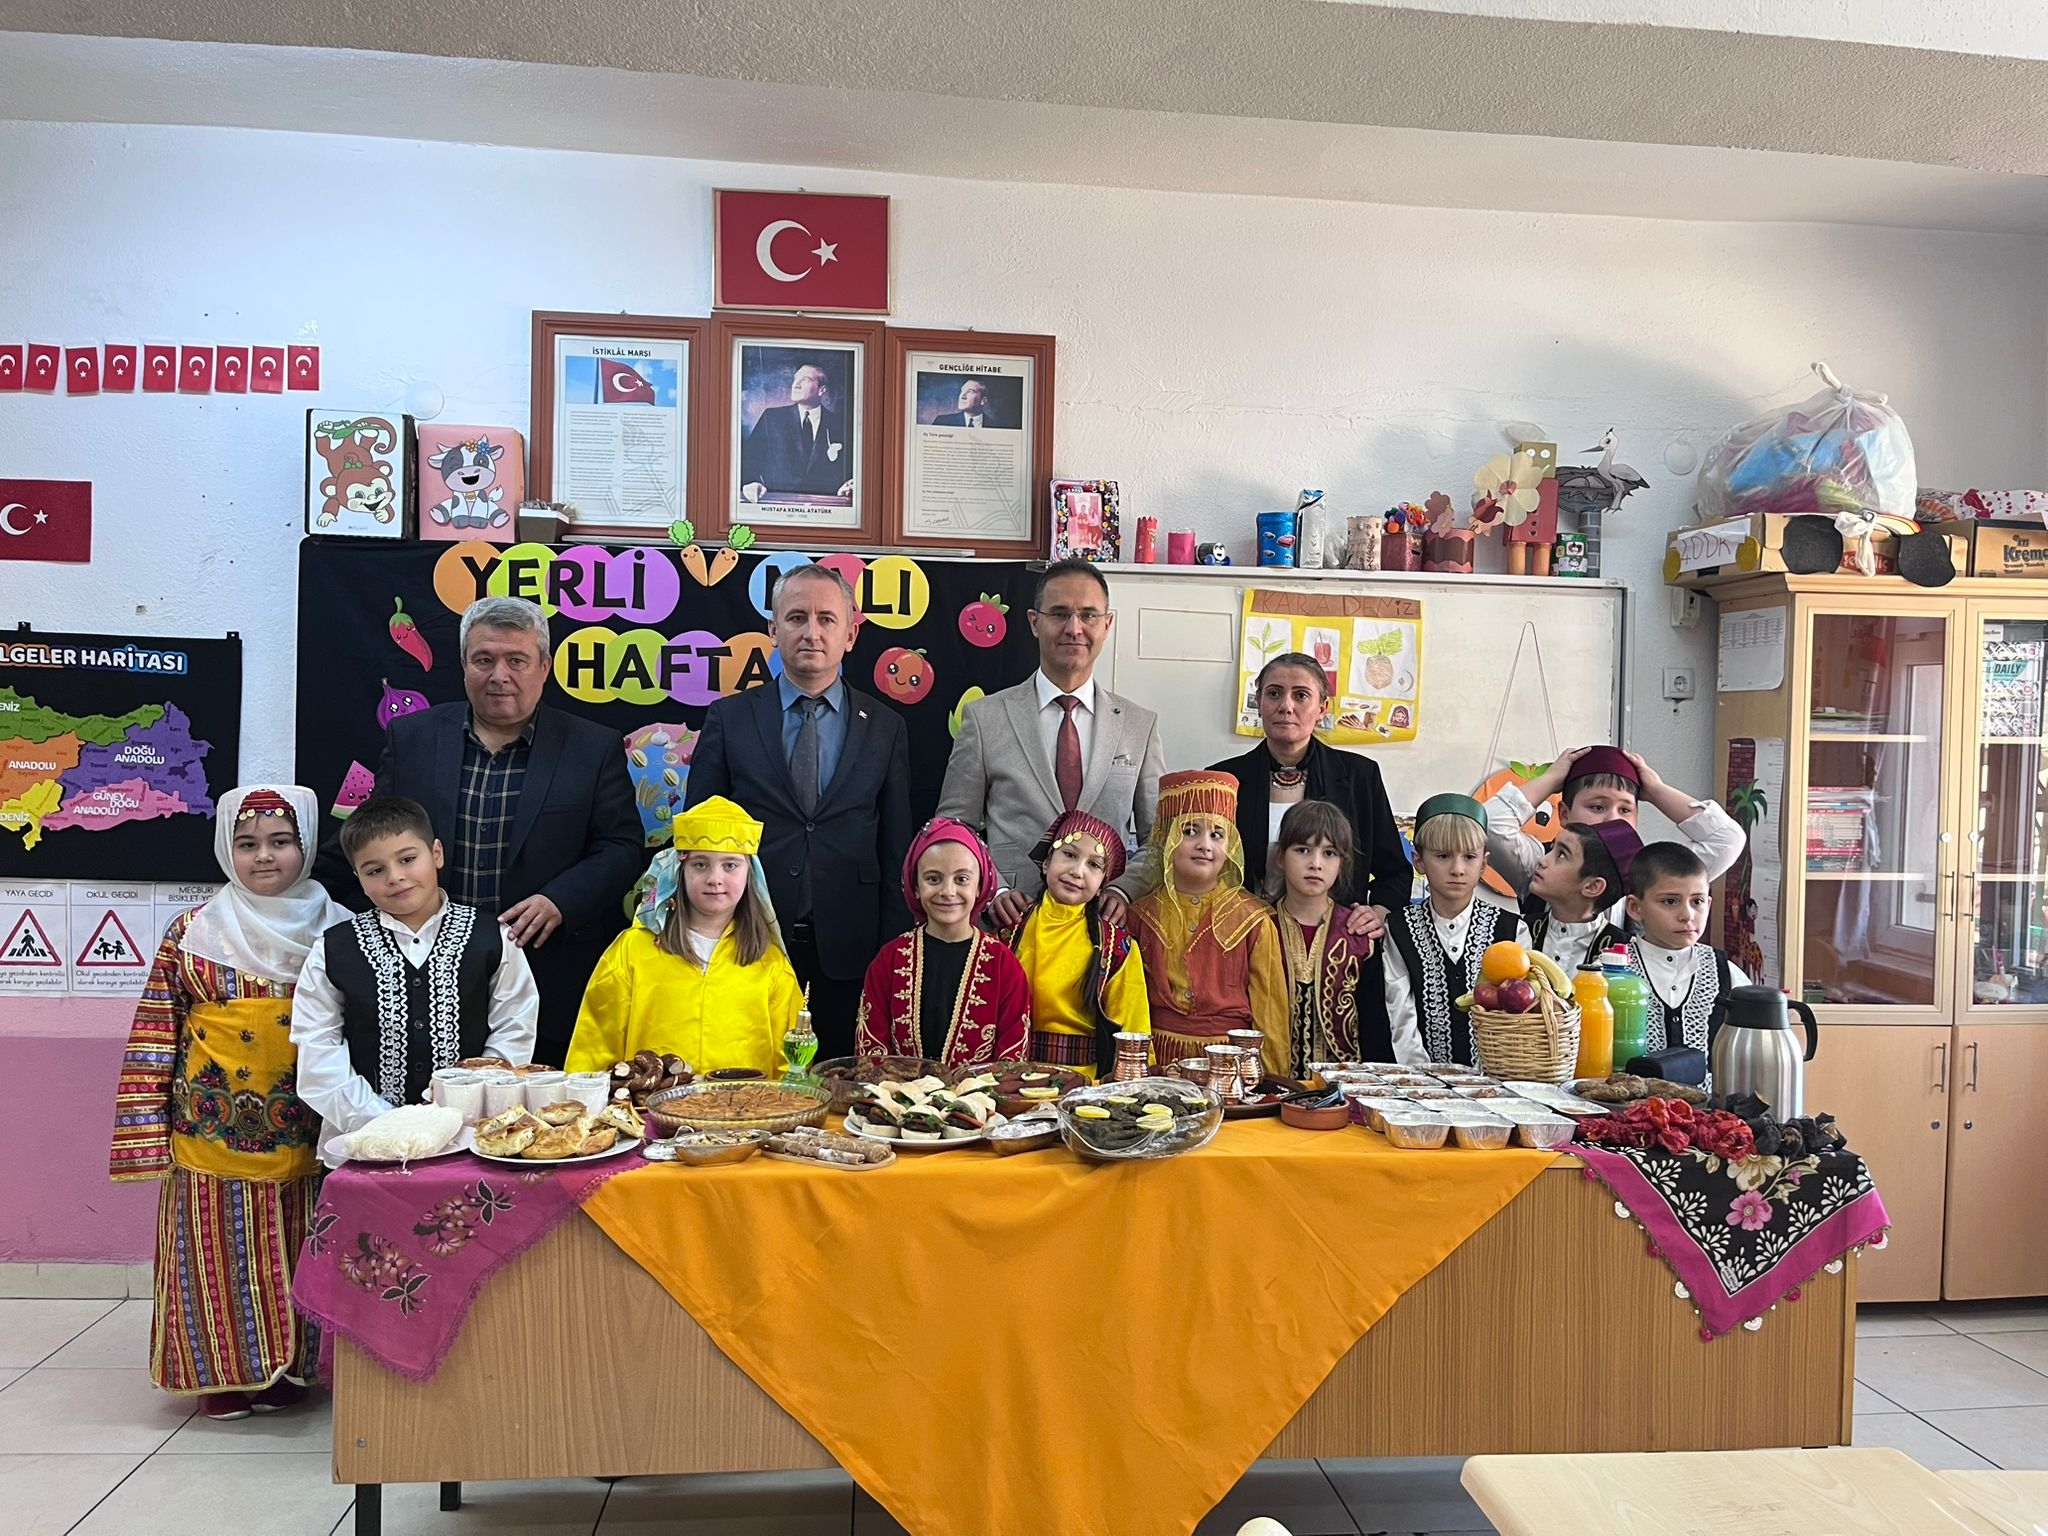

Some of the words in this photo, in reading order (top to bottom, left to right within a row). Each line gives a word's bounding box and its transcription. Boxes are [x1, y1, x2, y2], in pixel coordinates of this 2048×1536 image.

[592, 346, 626, 356] İSTİKLÂL
[627, 349, 651, 358] MARŞI
[938, 363, 975, 373] GENÇLİĞE
[975, 364, 1002, 374] HİTABE
[460, 550, 645, 610] YERLİ
[81, 646, 184, 671] HARİTASI
[1994, 663, 2022, 674] DAILY
[124, 745, 156, 756] DOĞU
[114, 754, 165, 765] ANADOLU
[8, 760, 57, 771] ANADOLU
[92, 790, 126, 801] GÜNEY
[109, 798, 139, 808] DOĞU
[0, 810, 30, 822] DENİZ
[73, 806, 120, 816] ANADOLU
[5, 889, 26, 897] YAYA
[85, 890, 109, 899] OKUL
